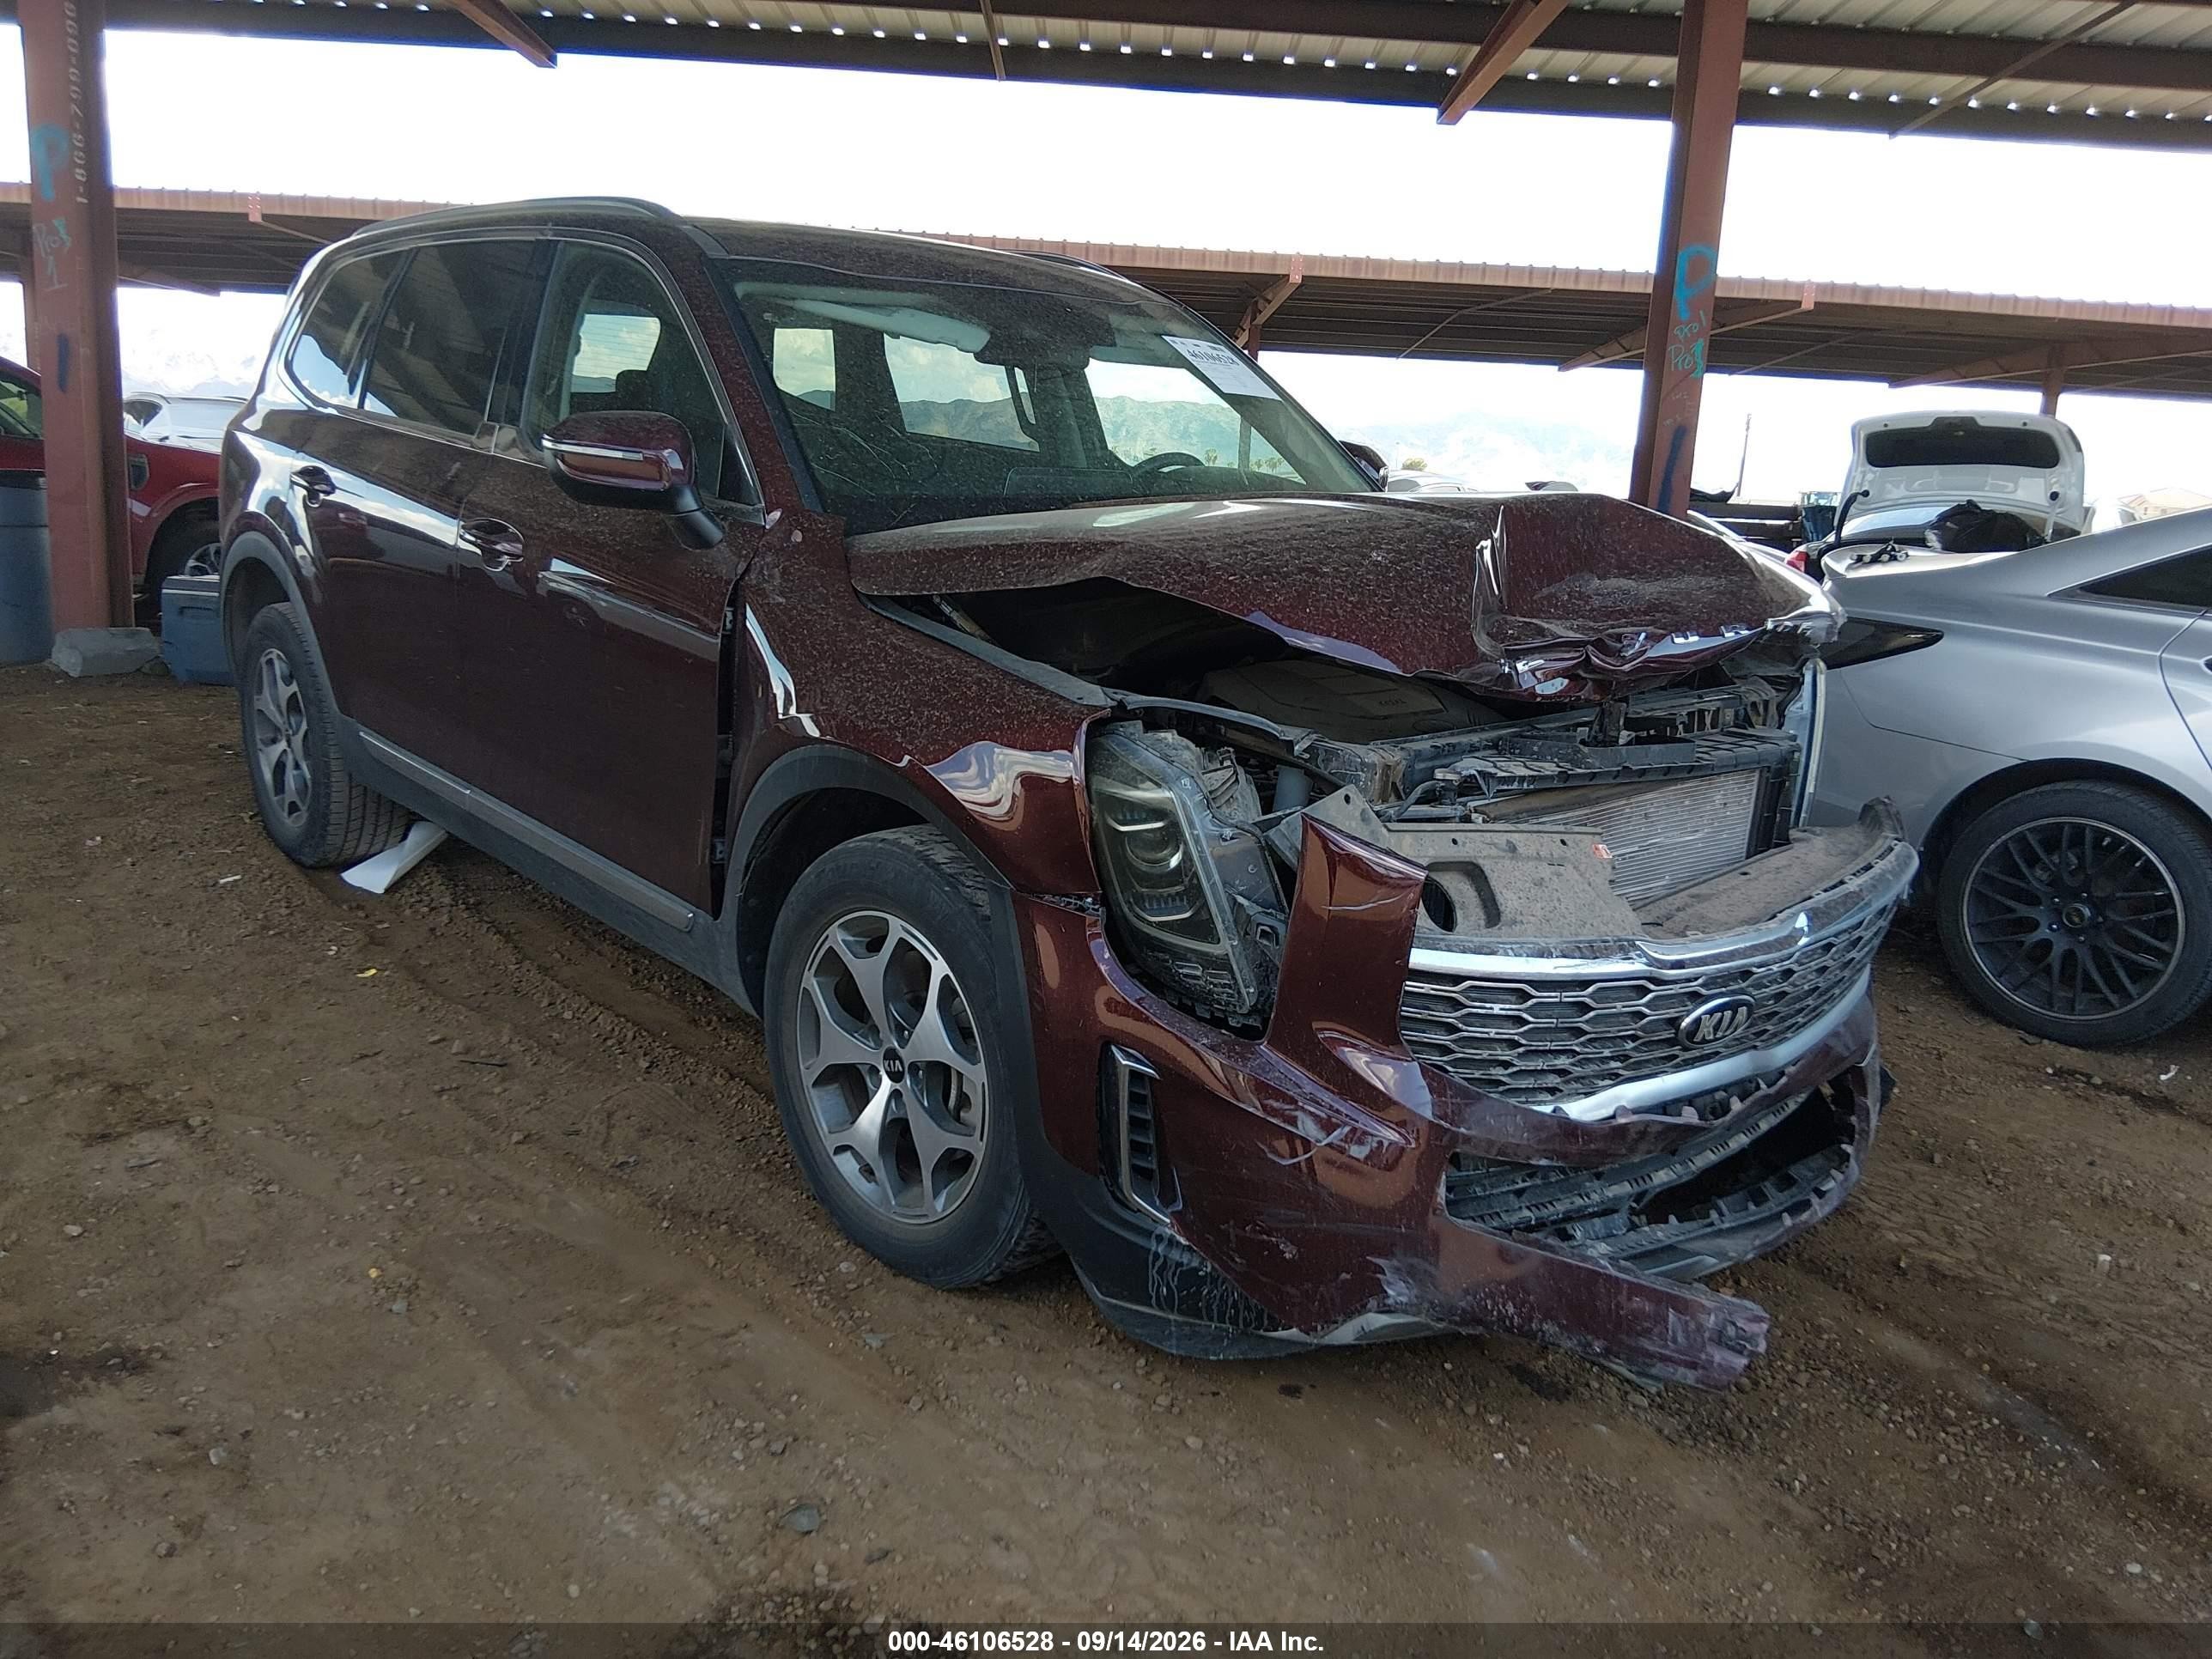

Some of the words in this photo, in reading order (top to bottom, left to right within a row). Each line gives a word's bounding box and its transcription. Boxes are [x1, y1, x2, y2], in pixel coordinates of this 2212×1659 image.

[1674, 243, 1718, 322] P
[1692, 1006, 1748, 1042] KIA
[883, 1059, 903, 1073] KIA
